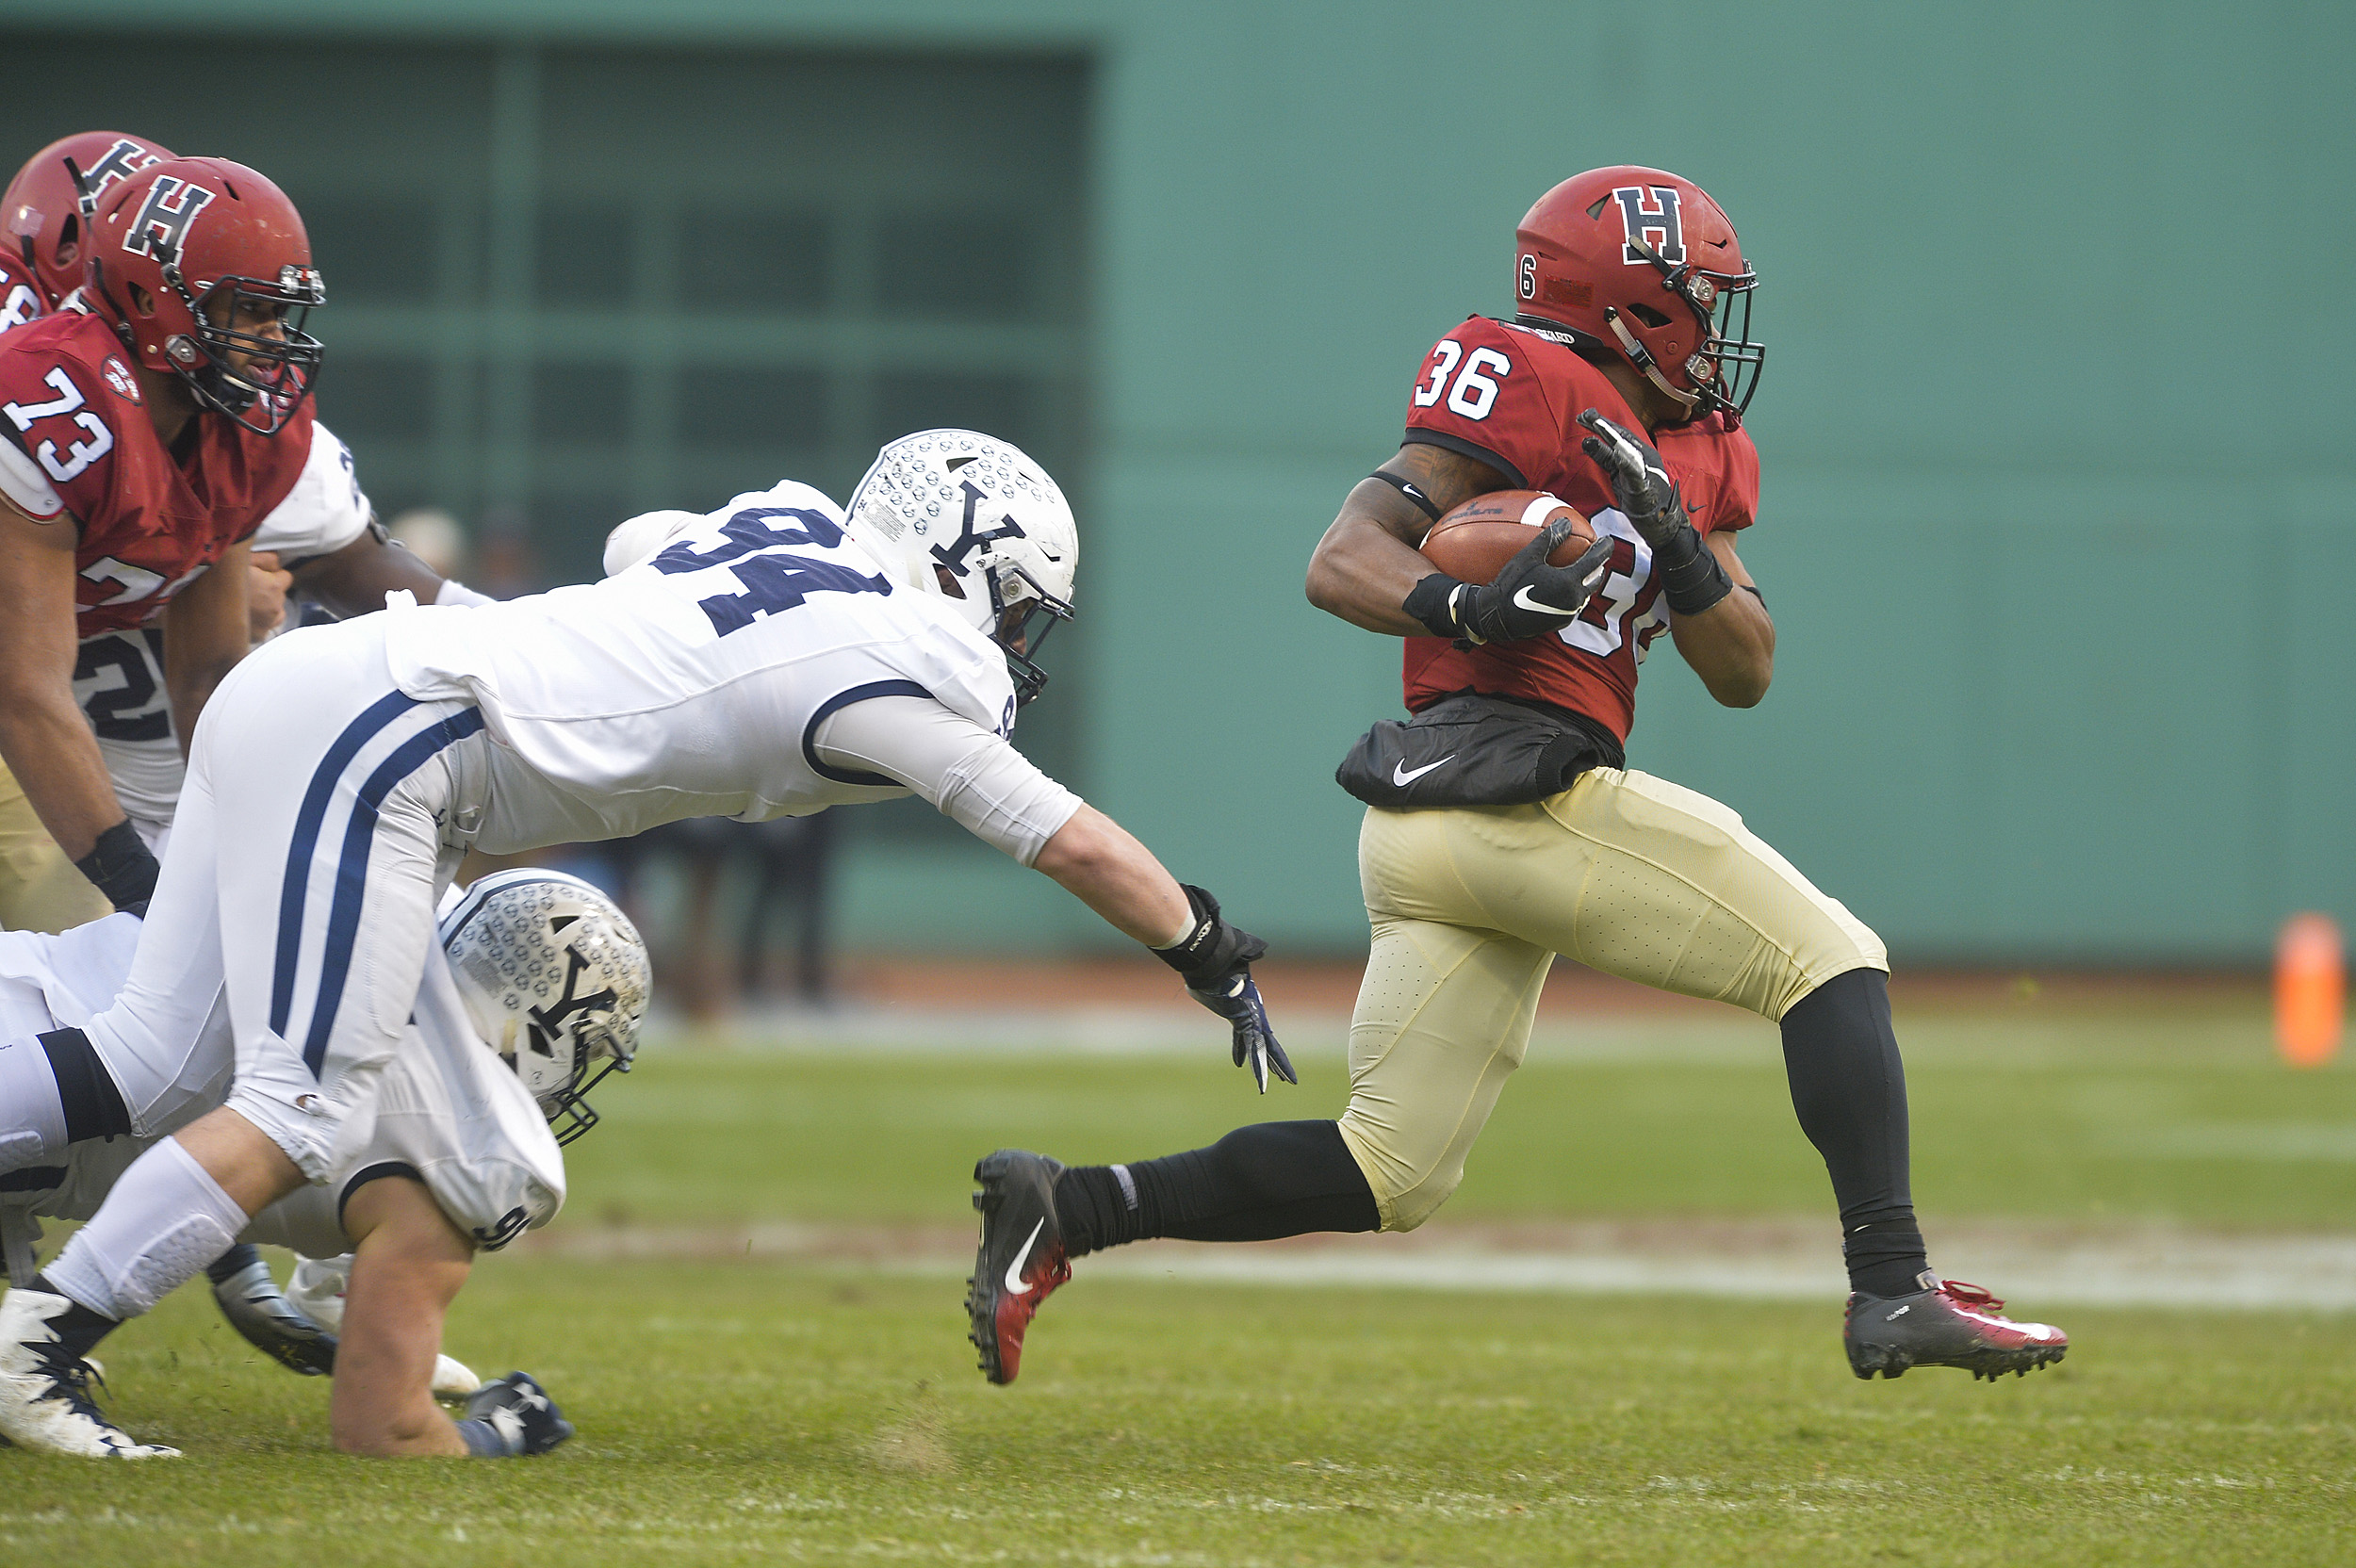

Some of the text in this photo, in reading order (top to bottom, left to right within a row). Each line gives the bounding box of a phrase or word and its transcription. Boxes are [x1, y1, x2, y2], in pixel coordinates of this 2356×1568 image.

[122, 174, 217, 267] H
[1612, 187, 1687, 265] H
[2, 366, 114, 483] 73
[1415, 339, 1512, 421] 36
[648, 508, 892, 638] 94
[928, 480, 1027, 578] Y
[527, 943, 618, 1041] Y
